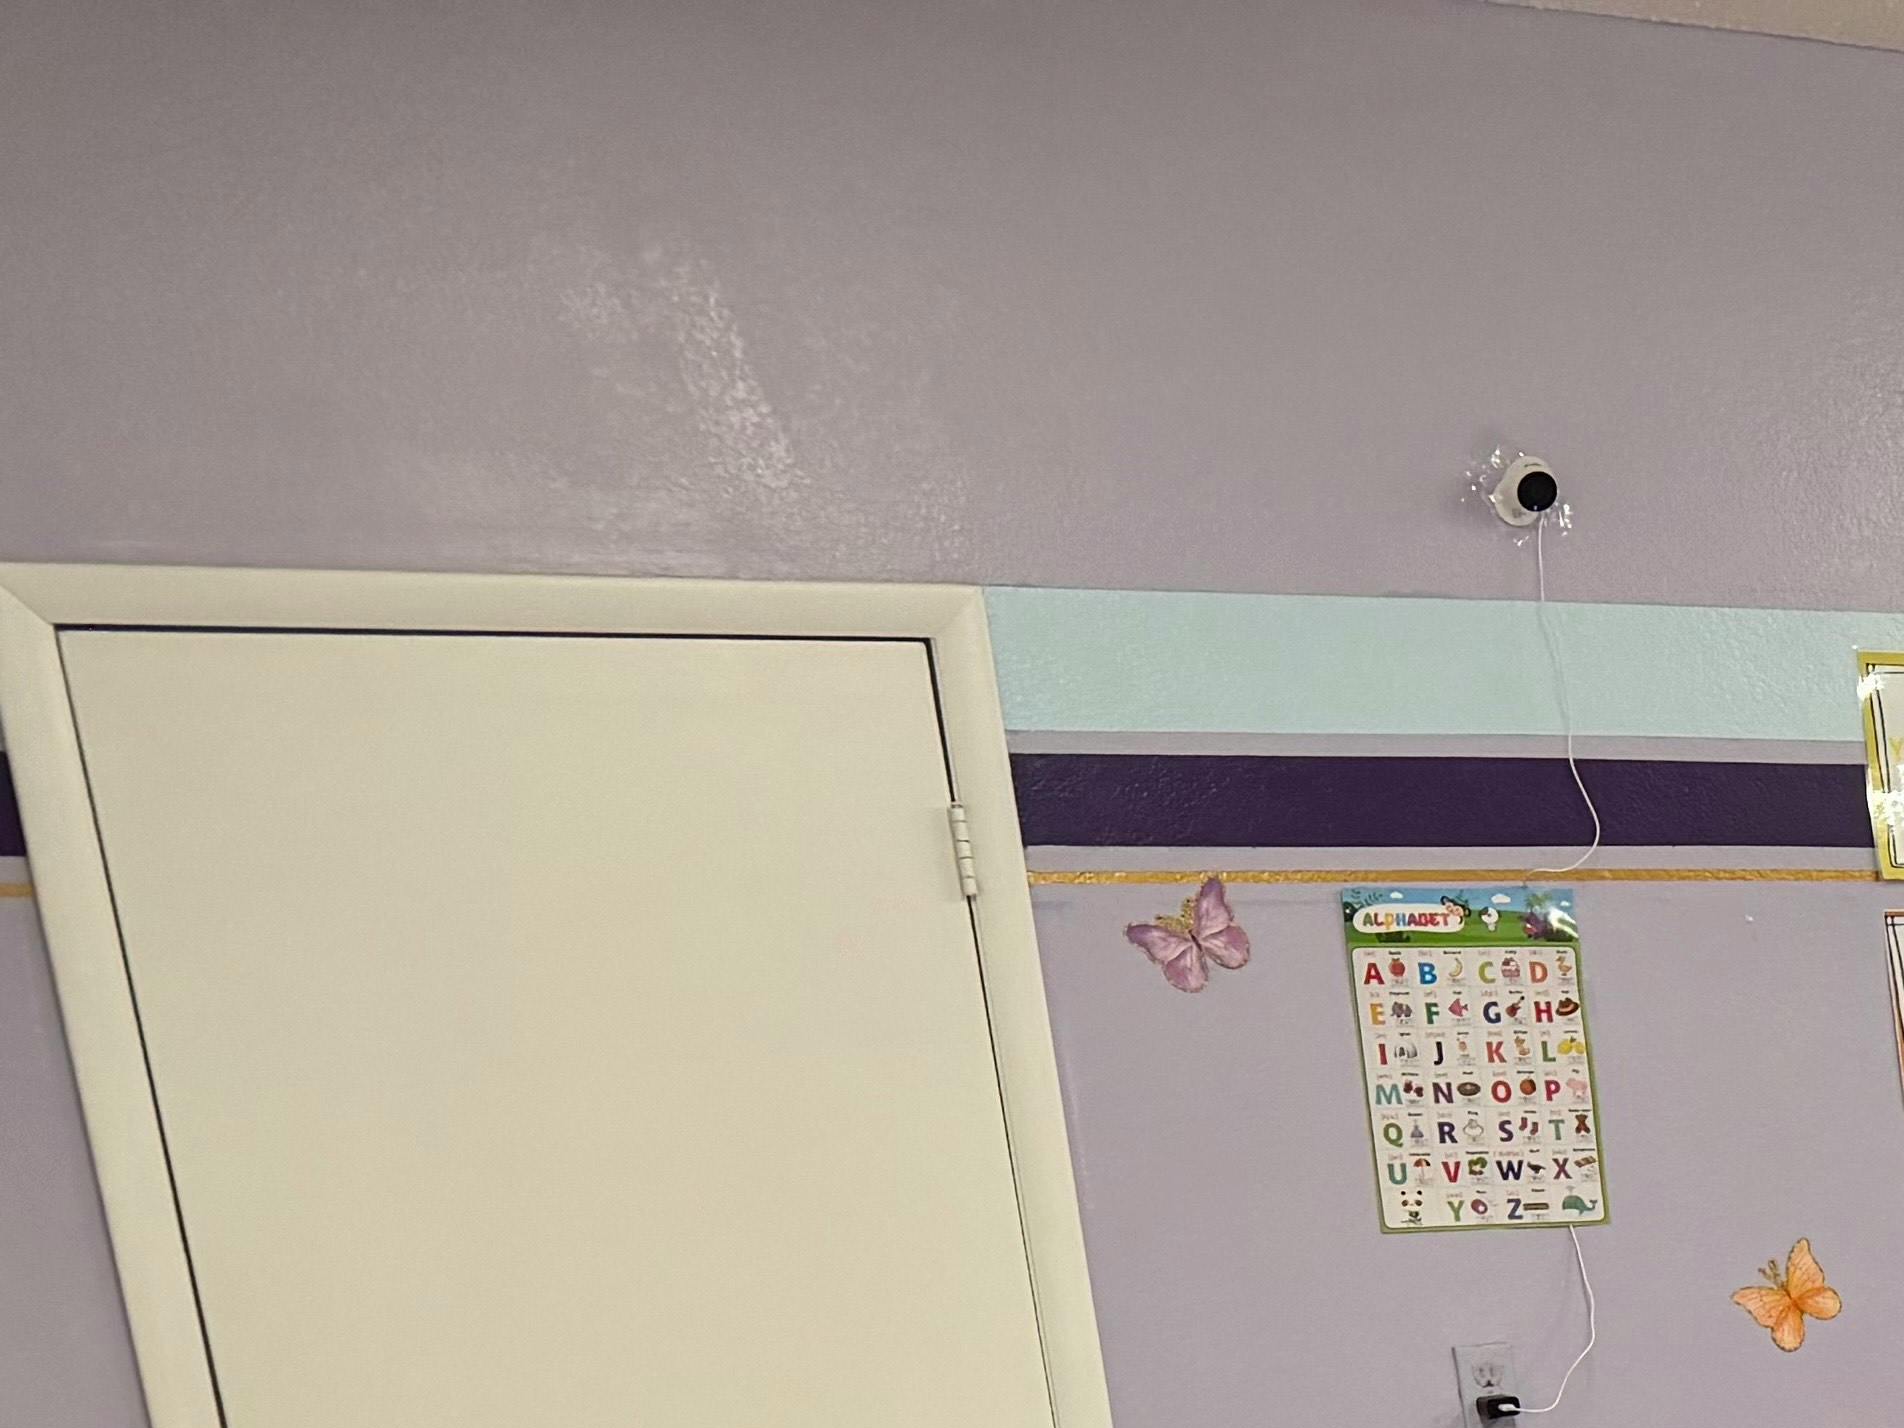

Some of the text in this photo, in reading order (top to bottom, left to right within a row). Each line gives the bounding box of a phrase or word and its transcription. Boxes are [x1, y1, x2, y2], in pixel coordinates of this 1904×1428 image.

[1363, 912, 1450, 930] ALPHABET
[1363, 963, 1385, 985] A
[1418, 962, 1438, 985] B
[1478, 961, 1496, 984] C
[1529, 961, 1548, 984] D
[1370, 1002, 1386, 1025] E
[1425, 1002, 1440, 1025] F
[1483, 1001, 1502, 1024] G
[1533, 1001, 1554, 1023] H
[1378, 1043, 1388, 1065] I
[1433, 1041, 1444, 1065] J
[1485, 1041, 1508, 1063] K
[1541, 1041, 1557, 1063] L
[1375, 1083, 1403, 1105] M
[1432, 1082, 1454, 1104] N
[1491, 1080, 1512, 1104] O
[1544, 1079, 1561, 1101] P
[1383, 1122, 1404, 1148] Q
[1437, 1121, 1458, 1144] R
[1498, 1120, 1514, 1142] S
[1548, 1119, 1565, 1141] T
[1387, 1163, 1408, 1186] U
[1441, 1161, 1462, 1183] V
[1496, 1160, 1524, 1181] W
[1552, 1157, 1573, 1180] X
[1447, 1200, 1465, 1222] Y
[1507, 1198, 1524, 1220] Z
